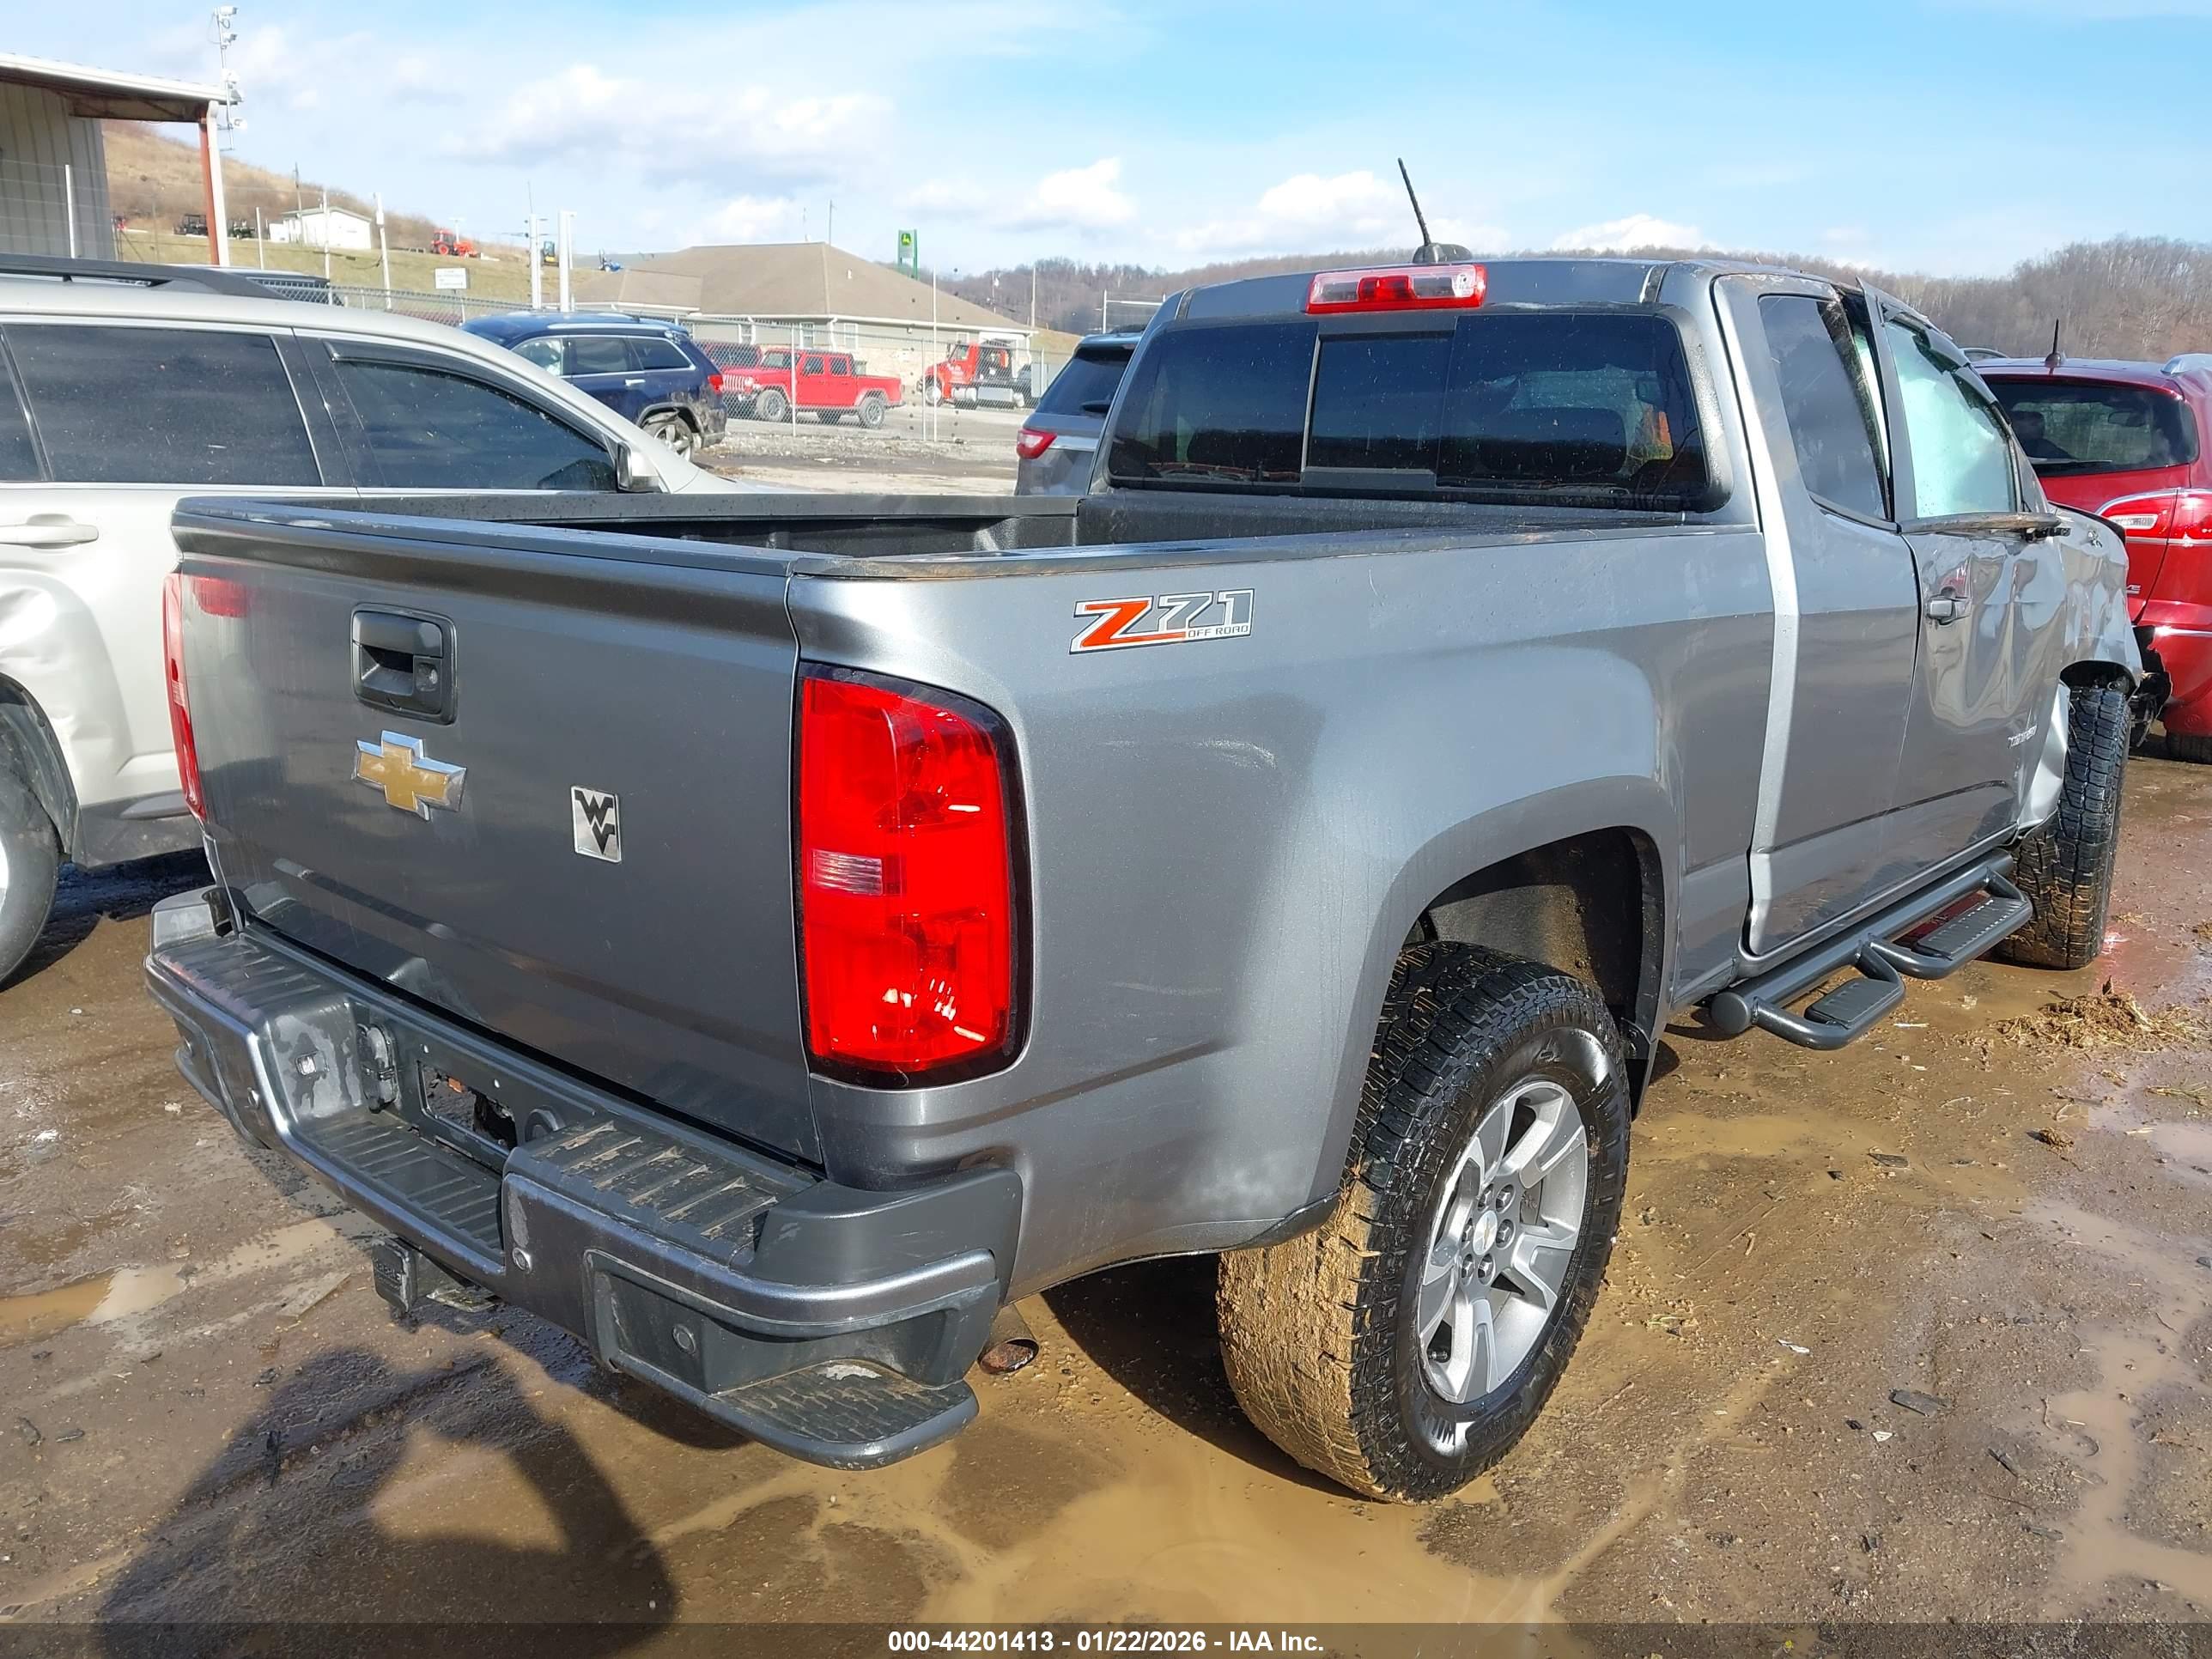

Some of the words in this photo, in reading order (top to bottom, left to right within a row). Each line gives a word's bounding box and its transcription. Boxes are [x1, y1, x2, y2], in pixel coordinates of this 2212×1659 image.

[1069, 588, 1255, 654] Z71
[1188, 629, 1211, 638] OFF
[1215, 625, 1249, 635] ROAD
